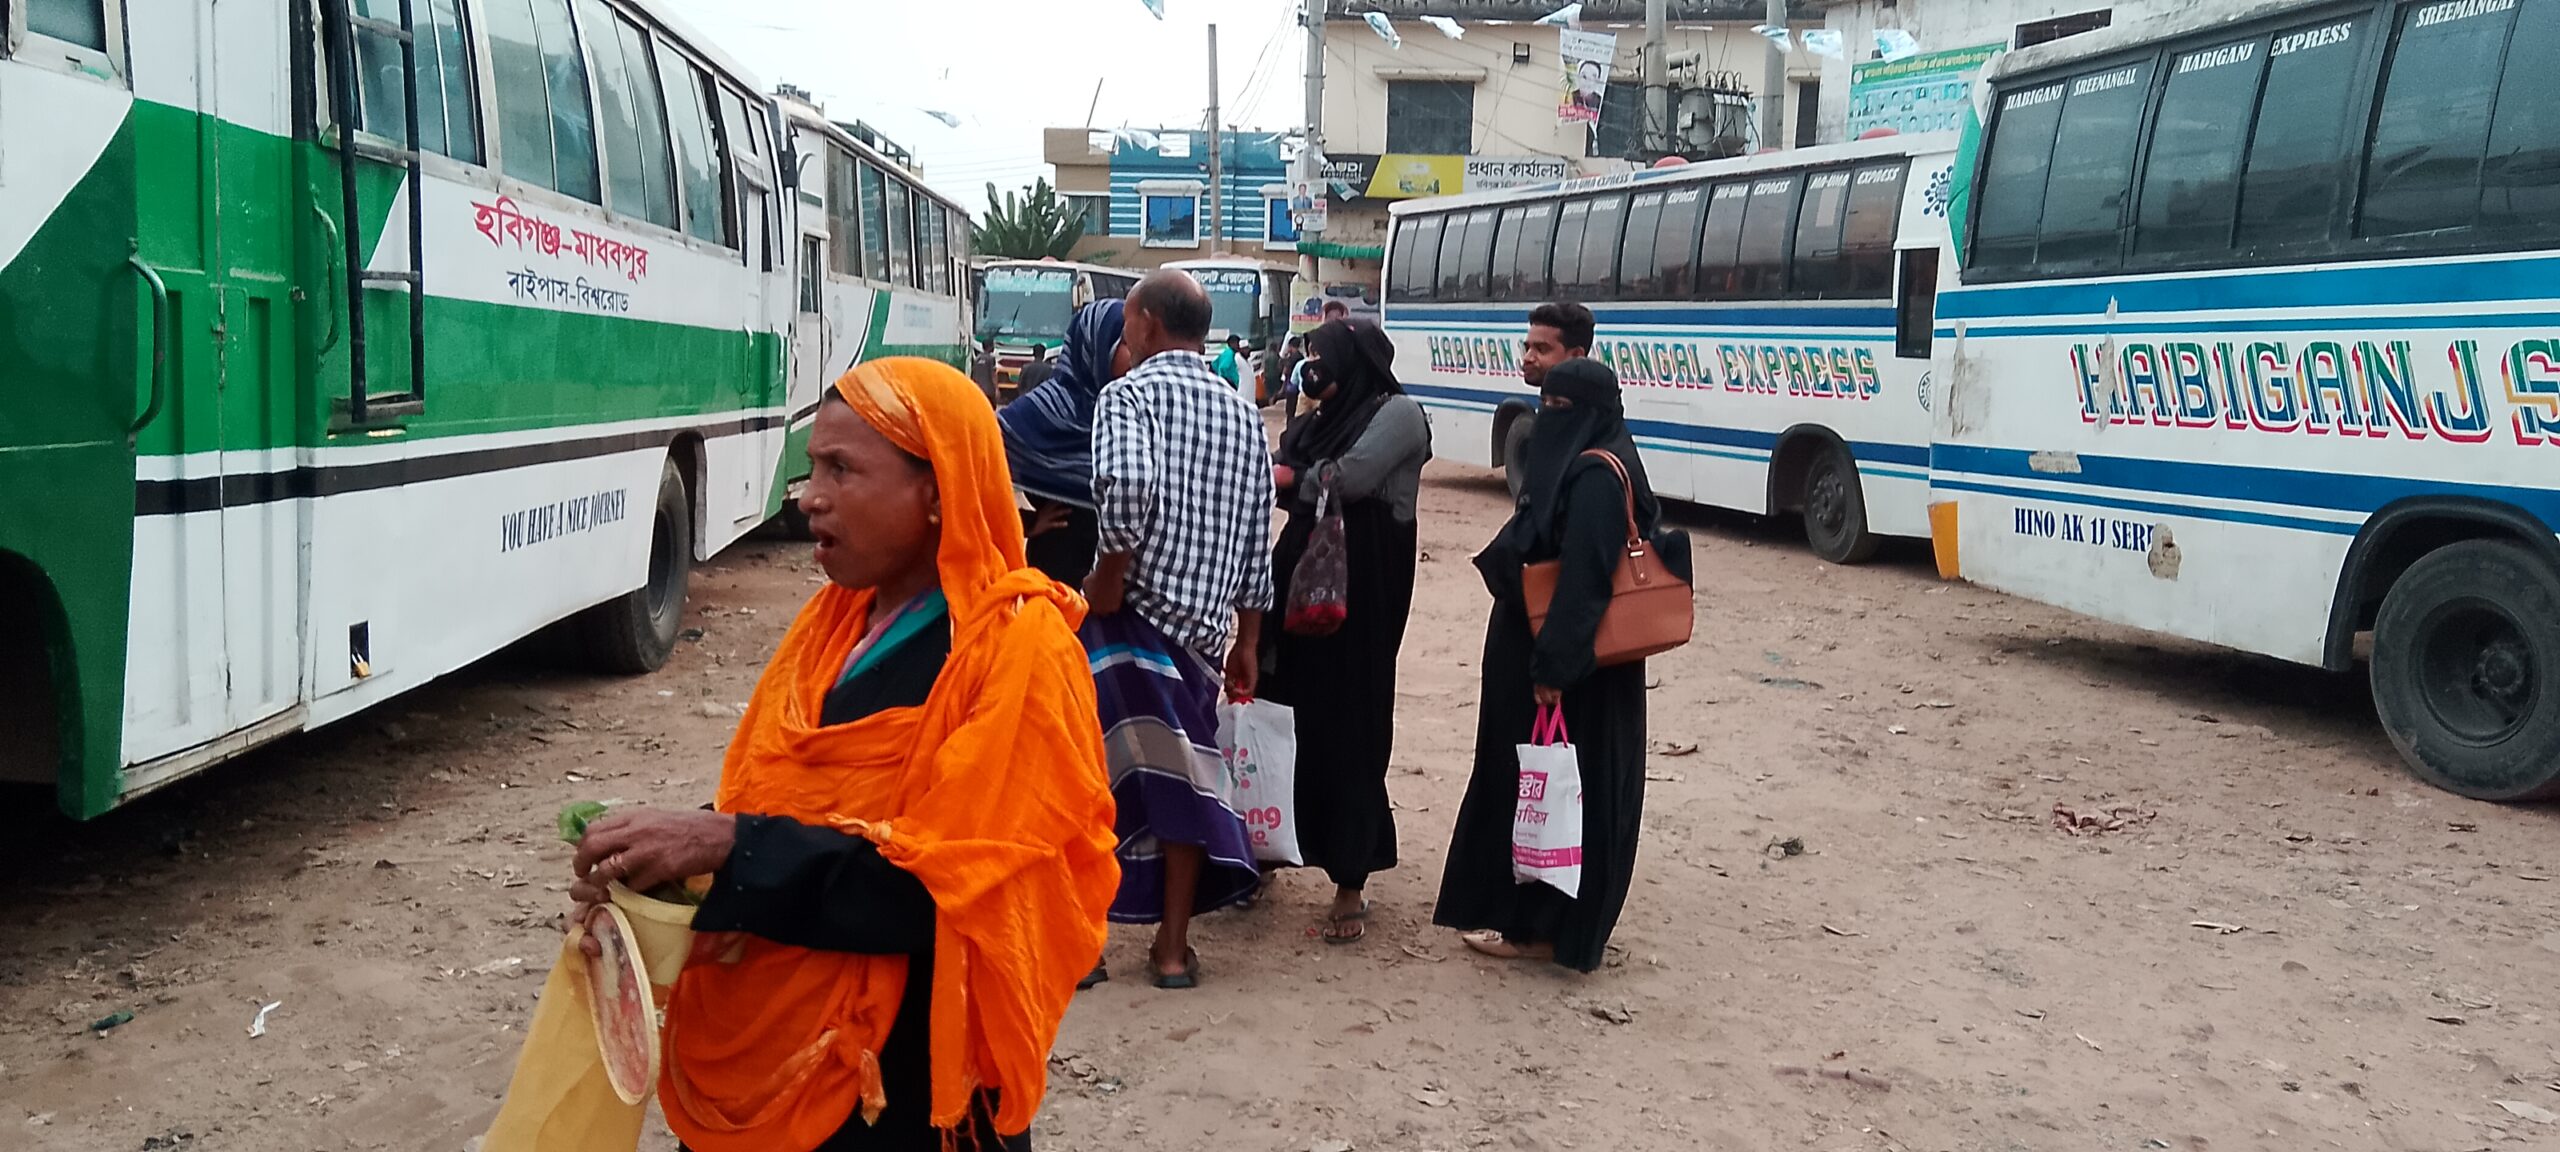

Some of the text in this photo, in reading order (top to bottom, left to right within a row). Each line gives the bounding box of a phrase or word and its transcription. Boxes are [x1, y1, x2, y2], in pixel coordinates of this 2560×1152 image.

[2178, 22, 2352, 74] HABIGANJ EXPRESS
[2004, 68, 2138, 111] HABIGANJ SREEMANGAL
[1467, 161, 1504, 177] প্রধান
[1596, 173, 1629, 187] EXPRESS
[1753, 180, 1791, 196] EXPRESS
[1856, 167, 1900, 185] EXPRESS
[470, 195, 649, 284] হবিগঞ্জ-মাধবপুর
[1593, 340, 1714, 392] MANGAL
[1716, 343, 1882, 401] EXPRESS
[2069, 339, 2493, 444] HABIGANJ
[501, 488, 627, 553] YOU HAVE A NICE JOURNEY
[2014, 507, 2056, 539] HINO
[2061, 513, 2085, 543] AK
